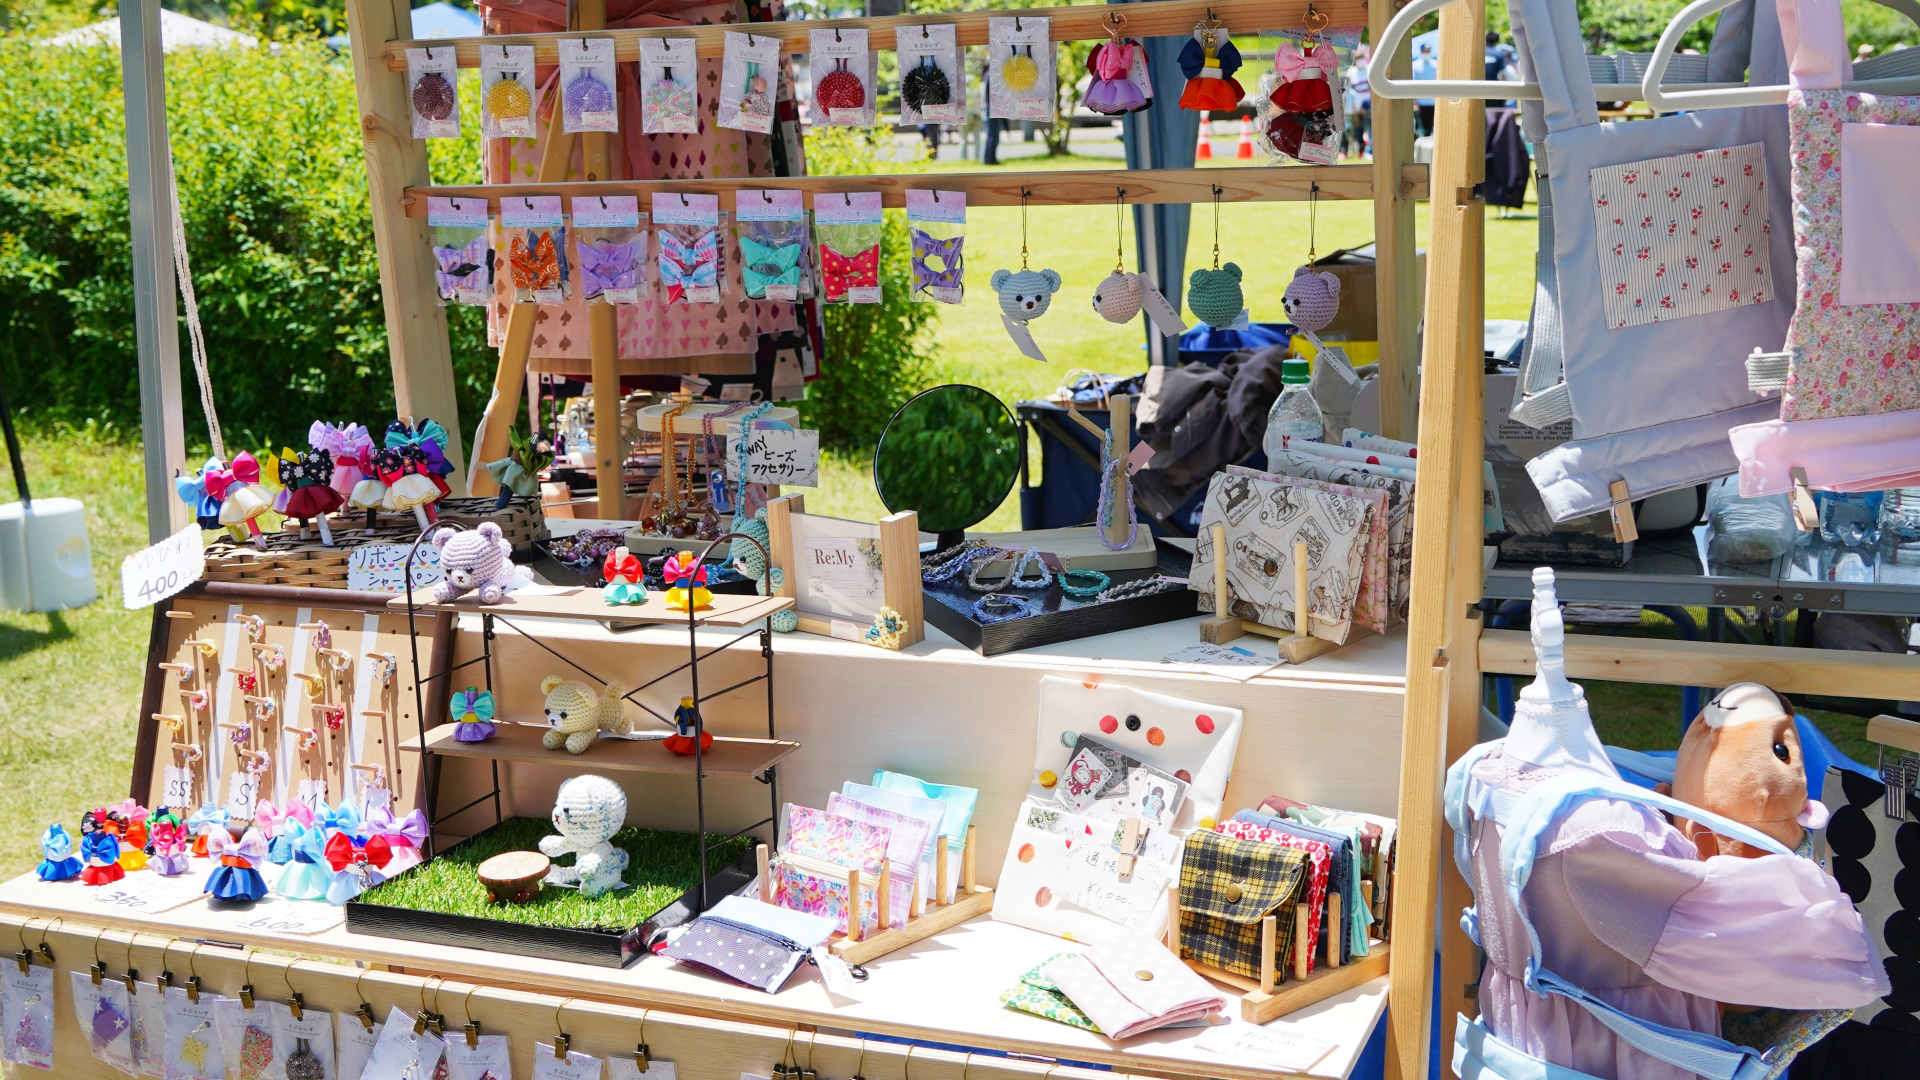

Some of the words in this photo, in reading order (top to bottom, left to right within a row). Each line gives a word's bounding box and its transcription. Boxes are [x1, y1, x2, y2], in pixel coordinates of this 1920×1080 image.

[735, 435, 768, 461] WAY
[764, 449, 797, 462] ビーズ
[751, 463, 806, 477] アクセサリー
[814, 548, 855, 568] Re:My
[170, 779, 188, 797] SS
[236, 782, 255, 806] S
[249, 917, 305, 931] 600
